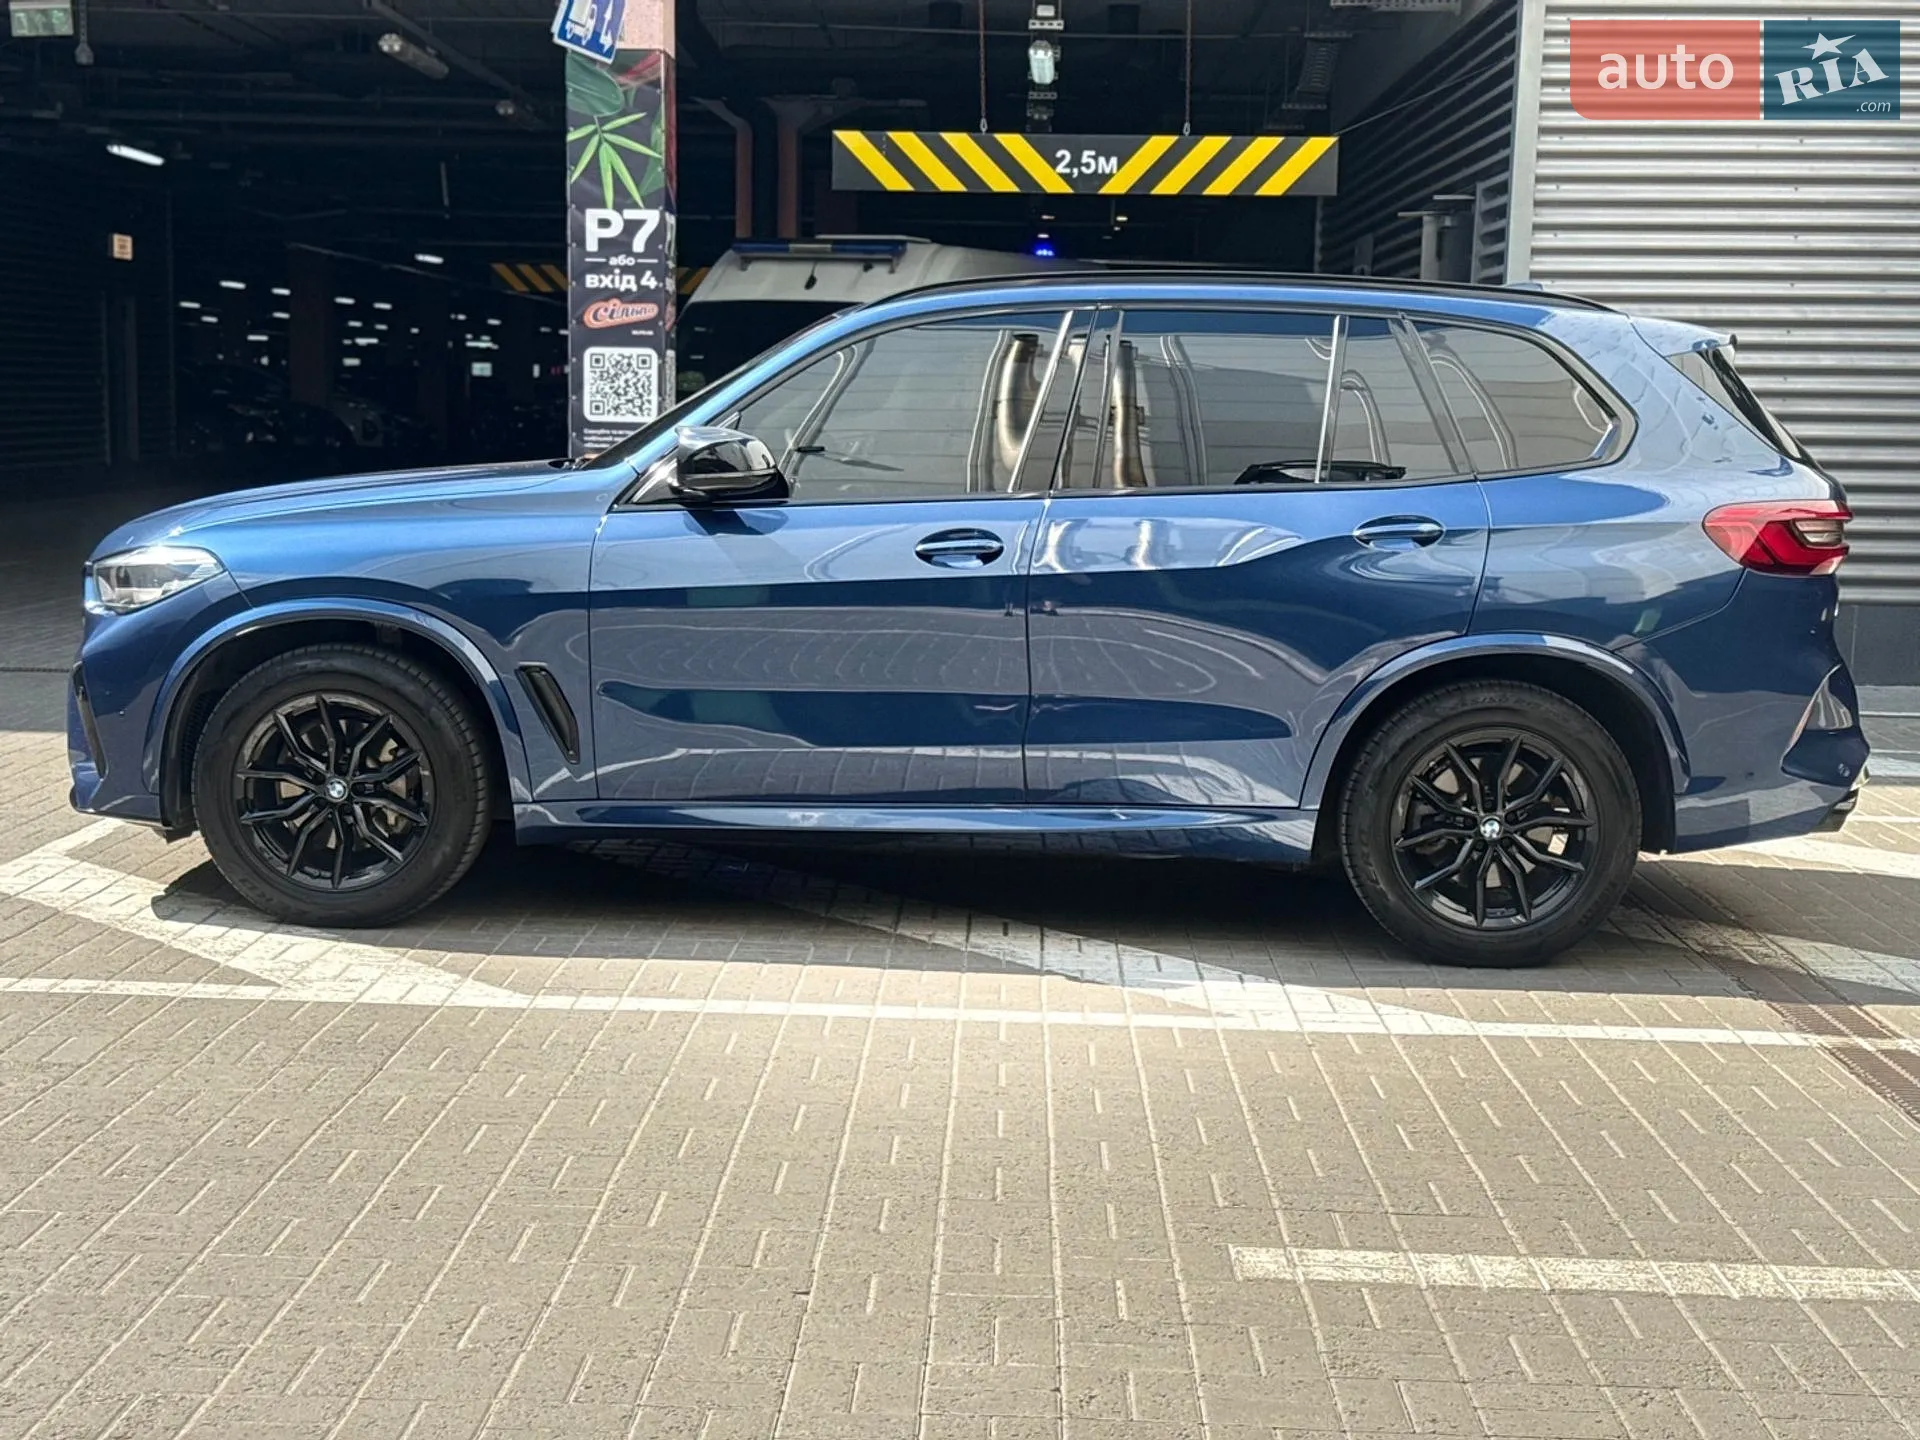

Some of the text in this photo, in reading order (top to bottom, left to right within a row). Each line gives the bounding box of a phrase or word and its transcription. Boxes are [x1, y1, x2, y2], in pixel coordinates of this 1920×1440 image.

[585, 208, 660, 253] P7
[608, 254, 636, 266] або
[640, 270, 658, 289] 4
